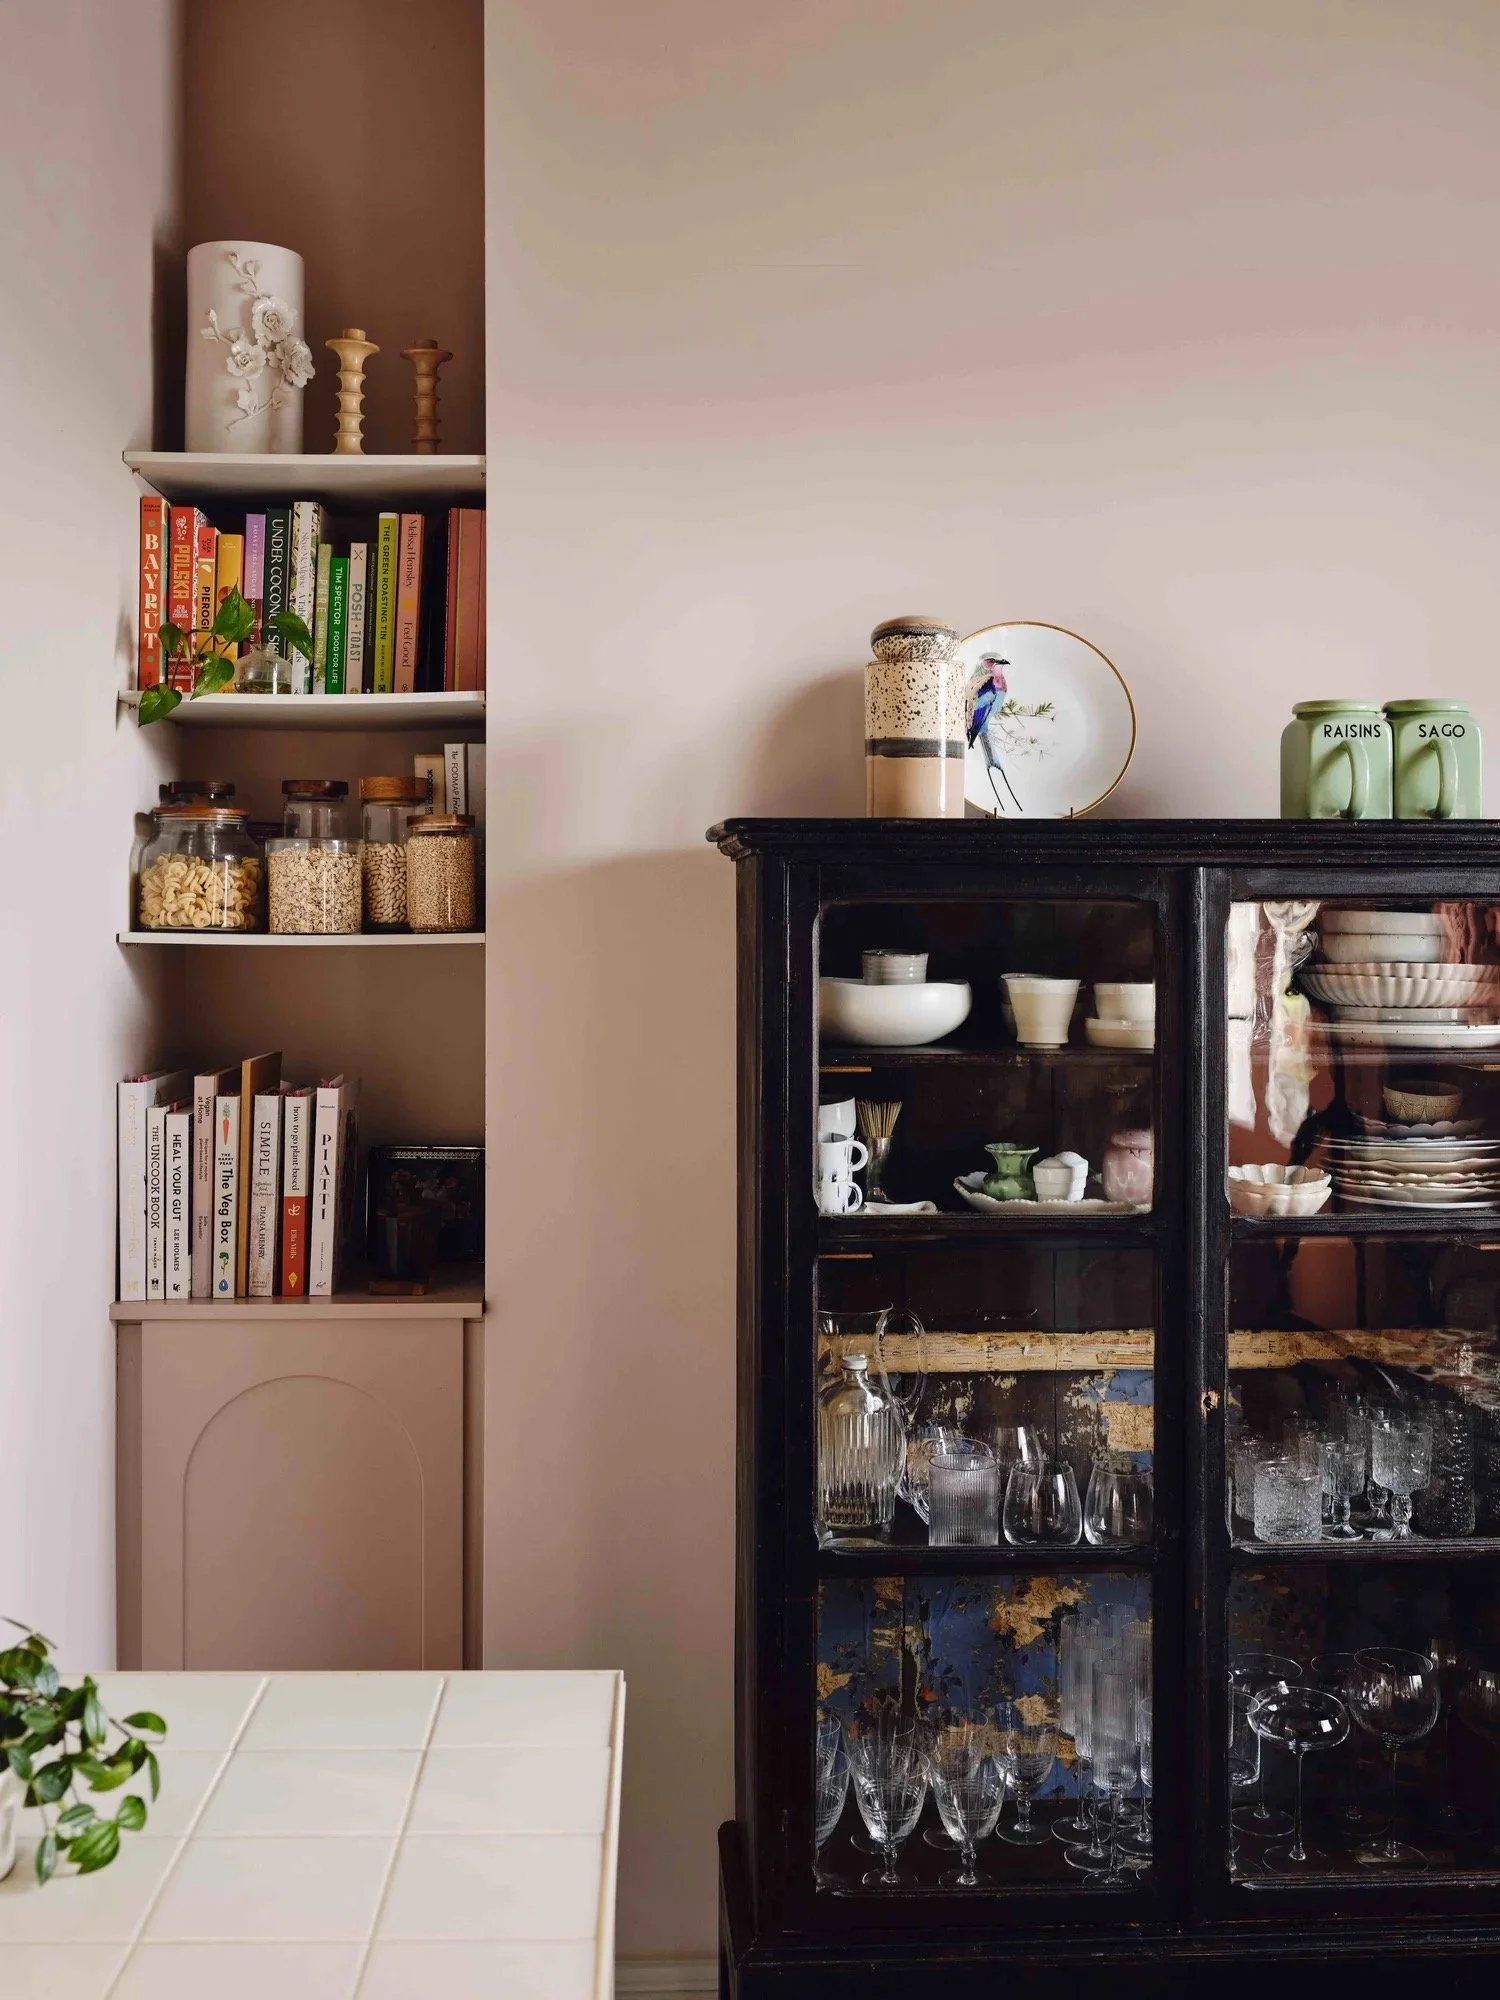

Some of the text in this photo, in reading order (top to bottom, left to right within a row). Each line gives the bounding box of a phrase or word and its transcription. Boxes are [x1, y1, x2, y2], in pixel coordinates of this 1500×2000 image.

[270, 519, 284, 563] UNDER
[300, 532, 310, 550] Skye
[382, 544, 390, 574] GREEN
[405, 519, 418, 587] Melissa Hemsley
[173, 544, 191, 599] POLSKA
[201, 586, 211, 629] PIEROGI
[298, 600, 306, 618] Tabl
[333, 567, 343, 625] TIM SPECTOR
[380, 578, 389, 623] ROASTING
[350, 584, 363, 662] POSH TOAST
[379, 625, 387, 640] TIN
[402, 622, 413, 668] Feel Good
[331, 670, 339, 683] LIFE
[1323, 724, 1381, 738] RAISINS
[1418, 723, 1466, 738] SAGO
[451, 762, 460, 795] FODMAP
[204, 1096, 212, 1117] Vegan
[151, 1144, 160, 1194] UNCOOK
[259, 1121, 271, 1176] SIMPLE
[290, 1106, 301, 1191] how to go plant-based
[172, 1134, 182, 1221] HEAL YOUR GUT
[319, 1134, 332, 1220] PIATTI
[150, 1197, 160, 1229] BOOK
[218, 1168, 234, 1243] The Veg Box
